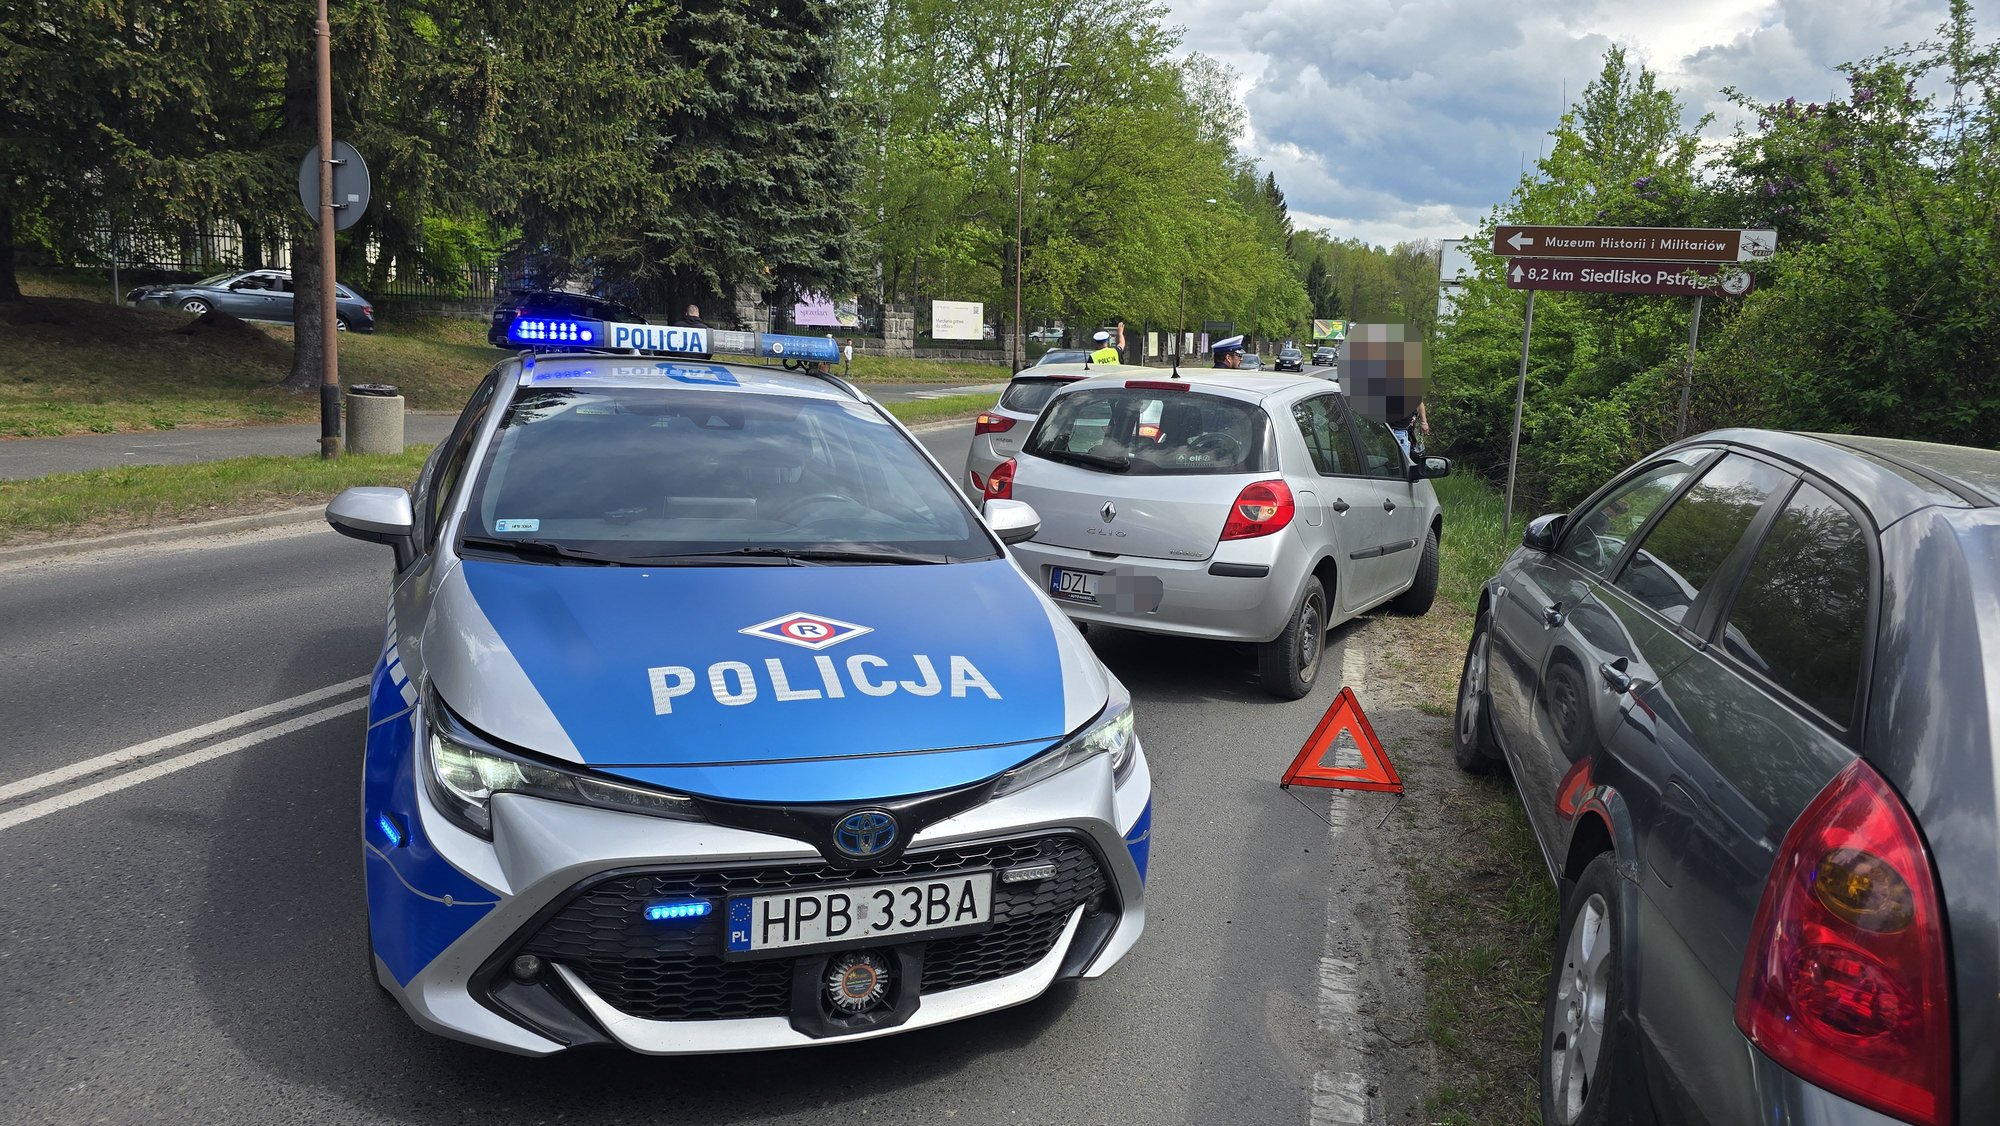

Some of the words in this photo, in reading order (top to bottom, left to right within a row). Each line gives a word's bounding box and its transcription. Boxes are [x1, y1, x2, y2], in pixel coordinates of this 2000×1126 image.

[1545, 236, 1595, 249] Muzeum
[1600, 237, 1647, 249] Historii
[1651, 237, 1656, 250] i
[1660, 239, 1727, 251] Militariów
[1527, 268, 1549, 282] 8,2
[1552, 268, 1574, 282] km
[1580, 269, 1652, 285] Siedlisko
[615, 326, 703, 352] POLICJA
[1086, 527, 1127, 538] CLIO
[1061, 572, 1092, 594] DZL
[797, 624, 820, 635] R
[647, 654, 1003, 715] POLICJA
[732, 931, 748, 943] PL
[762, 893, 852, 943] HPB
[871, 879, 978, 931] 33BA
